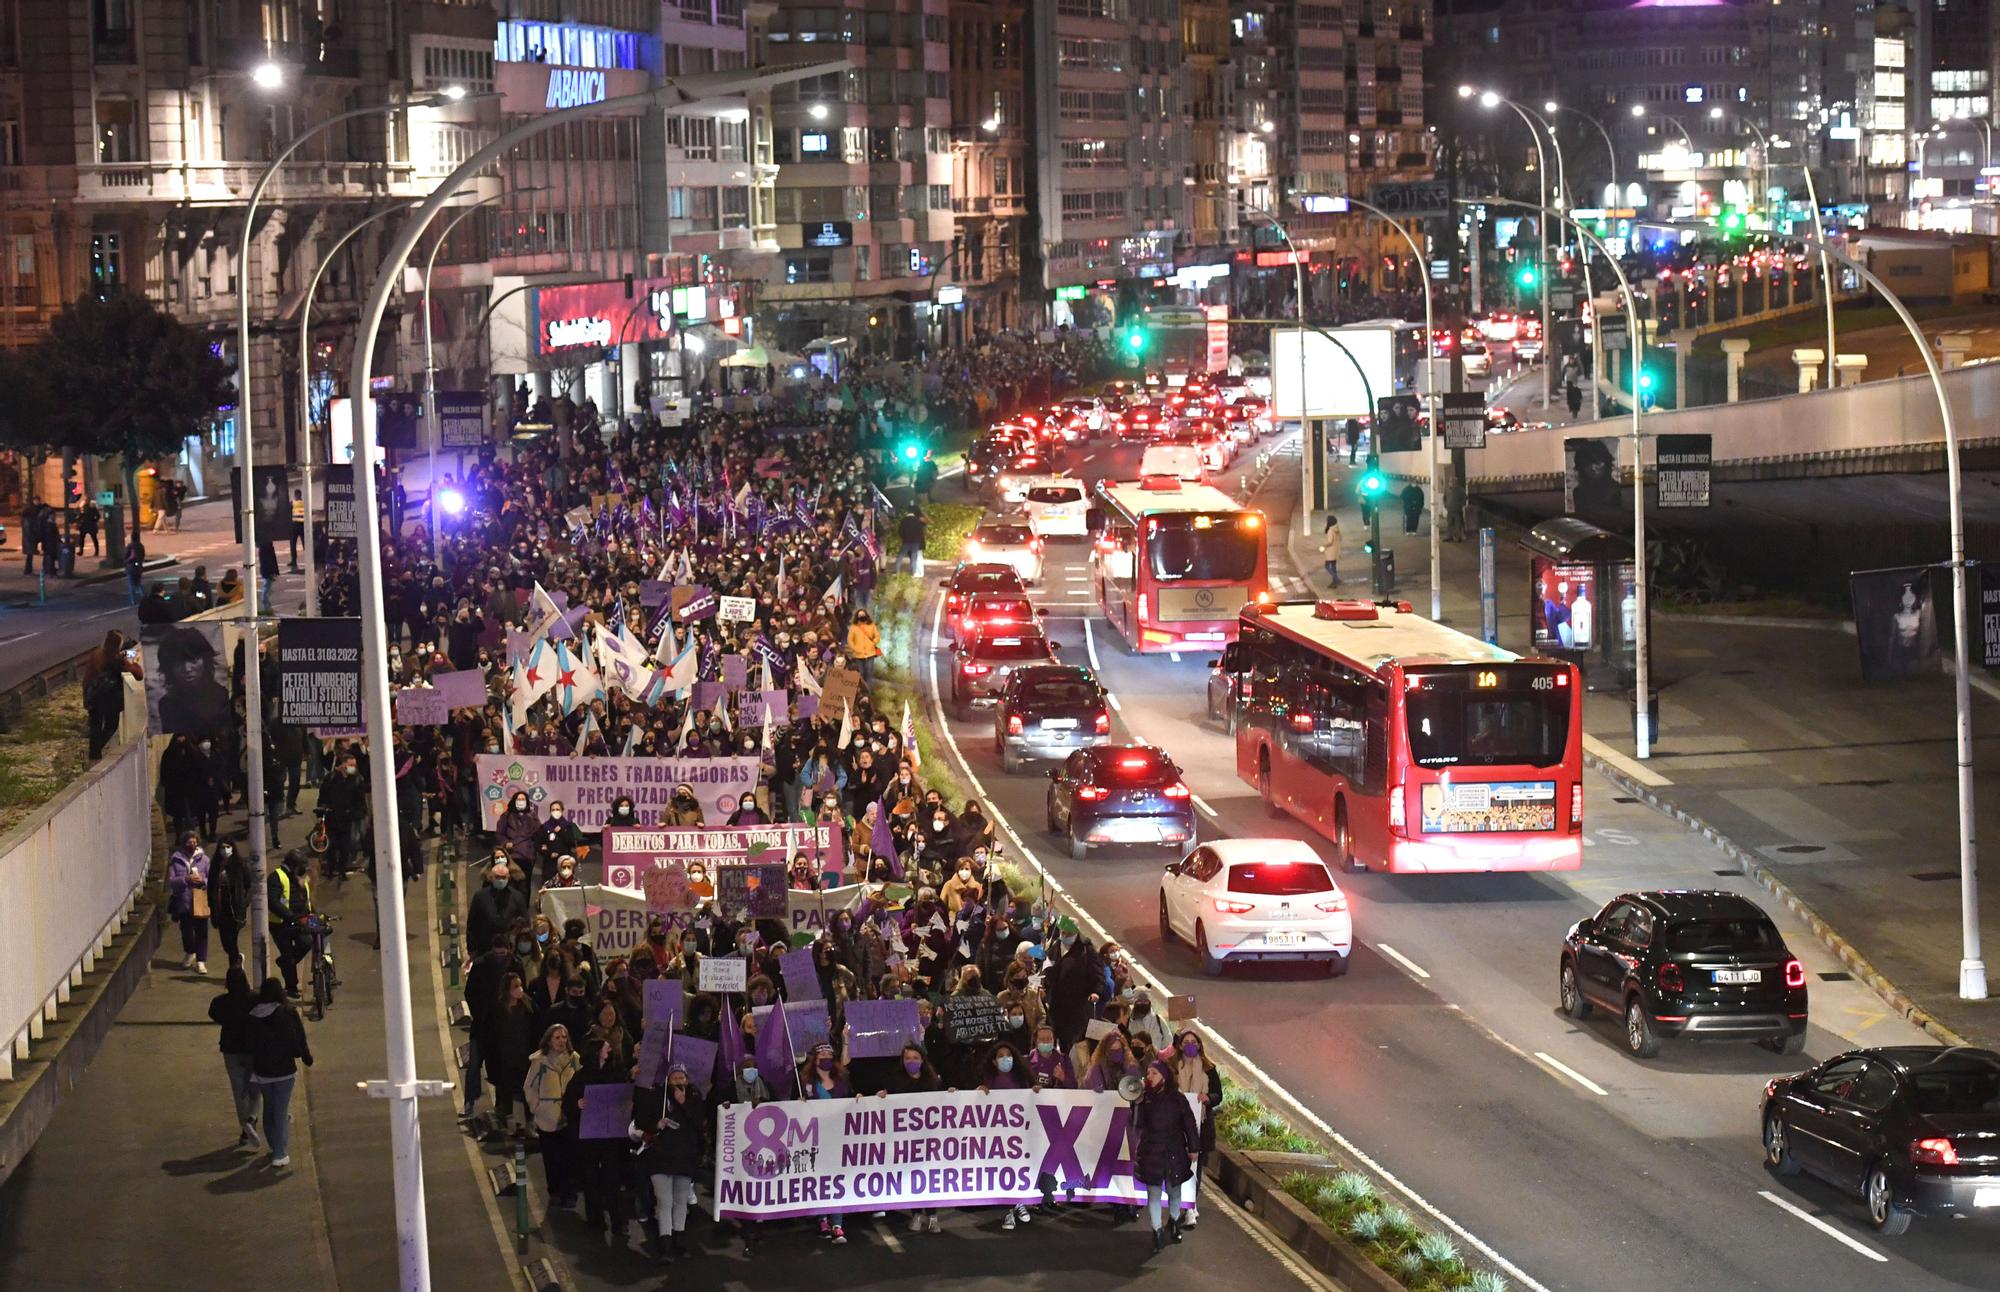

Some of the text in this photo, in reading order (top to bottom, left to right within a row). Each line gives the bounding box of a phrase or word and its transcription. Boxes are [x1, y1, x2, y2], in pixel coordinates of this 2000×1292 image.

[546, 69, 605, 107] ABANCA
[282, 648, 306, 661] HASTA
[307, 648, 315, 661] EL
[282, 673, 358, 688] PETER LINDBERGH
[1478, 672, 1497, 687] 1A
[1531, 677, 1554, 690] 405
[282, 687, 358, 702] UNTOLD STORIES
[282, 702, 289, 716] A
[325, 702, 358, 716] GALICIA
[546, 764, 750, 783] MULLERES TRABALLADORAS
[577, 787, 679, 804] PRECARIZADA
[612, 833, 665, 850] DEREITOS
[669, 833, 699, 850] PARA
[703, 832, 742, 850] TODAS,
[745, 831, 782, 848] TODOS
[682, 857, 747, 869] VILENCIA
[844, 1104, 1031, 1136] NIN ESCRAVAS,
[841, 1142, 886, 1167] NIN
[723, 1166, 735, 1175] A
[720, 1167, 1031, 1206] MULLERES CON DEREITOS
